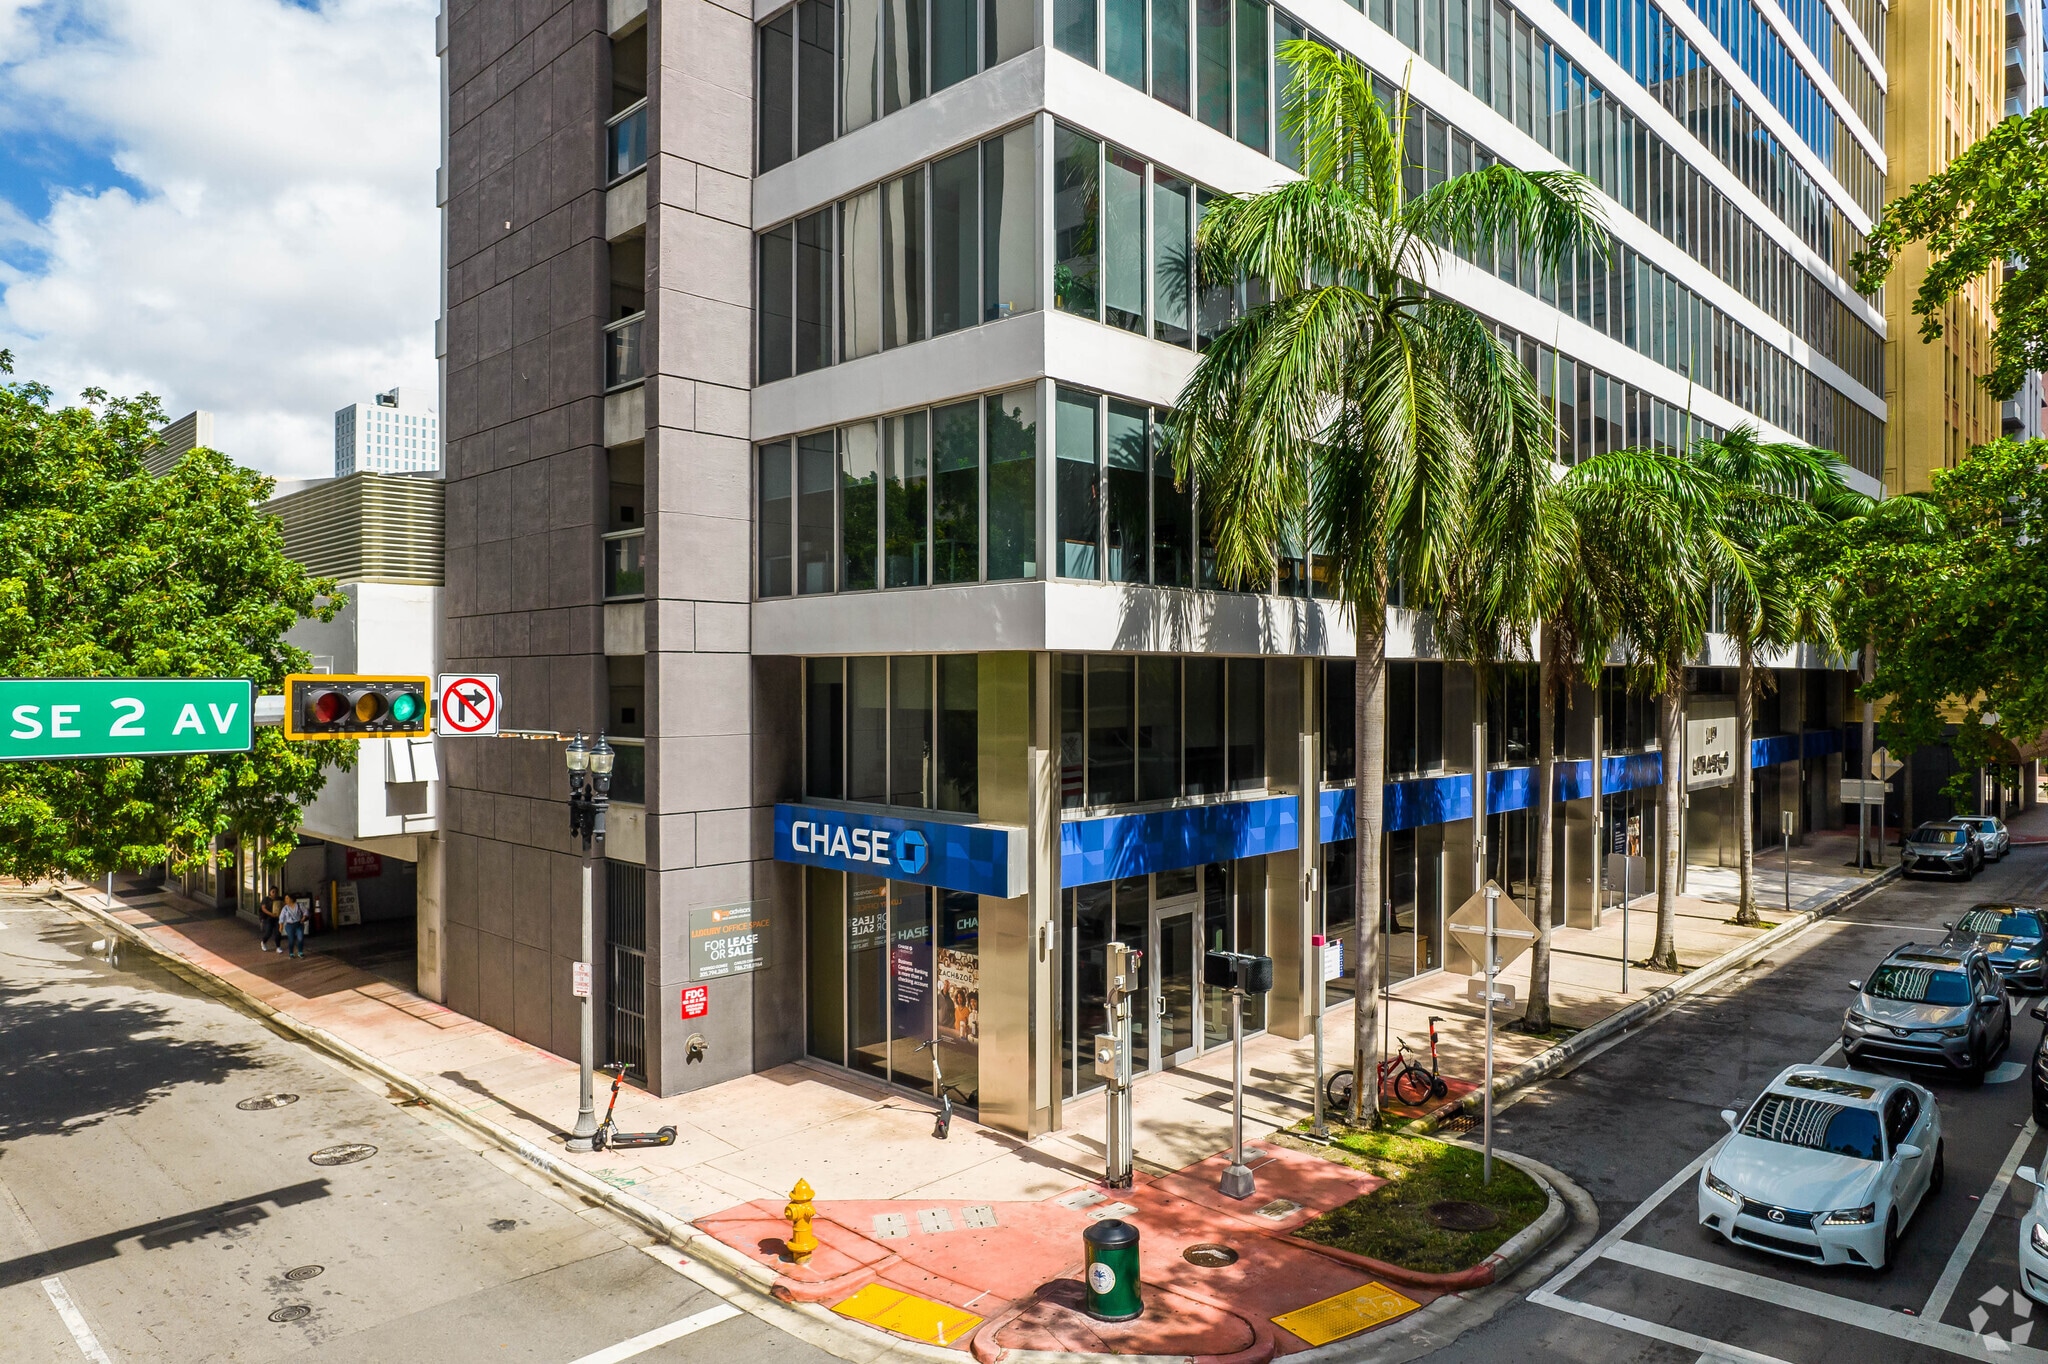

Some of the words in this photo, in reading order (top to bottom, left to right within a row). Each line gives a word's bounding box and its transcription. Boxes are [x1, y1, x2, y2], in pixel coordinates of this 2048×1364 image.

[10, 704, 81, 740] SE
[109, 697, 145, 737] 2
[172, 703, 239, 736] AV
[792, 821, 891, 865] CHASE
[691, 926, 721, 939] LUXURY
[722, 921, 748, 933] OFFICE
[749, 919, 769, 930] SPACE
[956, 916, 978, 930] CHA
[898, 925, 929, 940] HASE
[704, 938, 726, 952] FOR
[727, 934, 759, 948] LEASE
[710, 948, 726, 960] OR
[727, 944, 753, 958] SALE
[685, 988, 705, 1000] FDC
